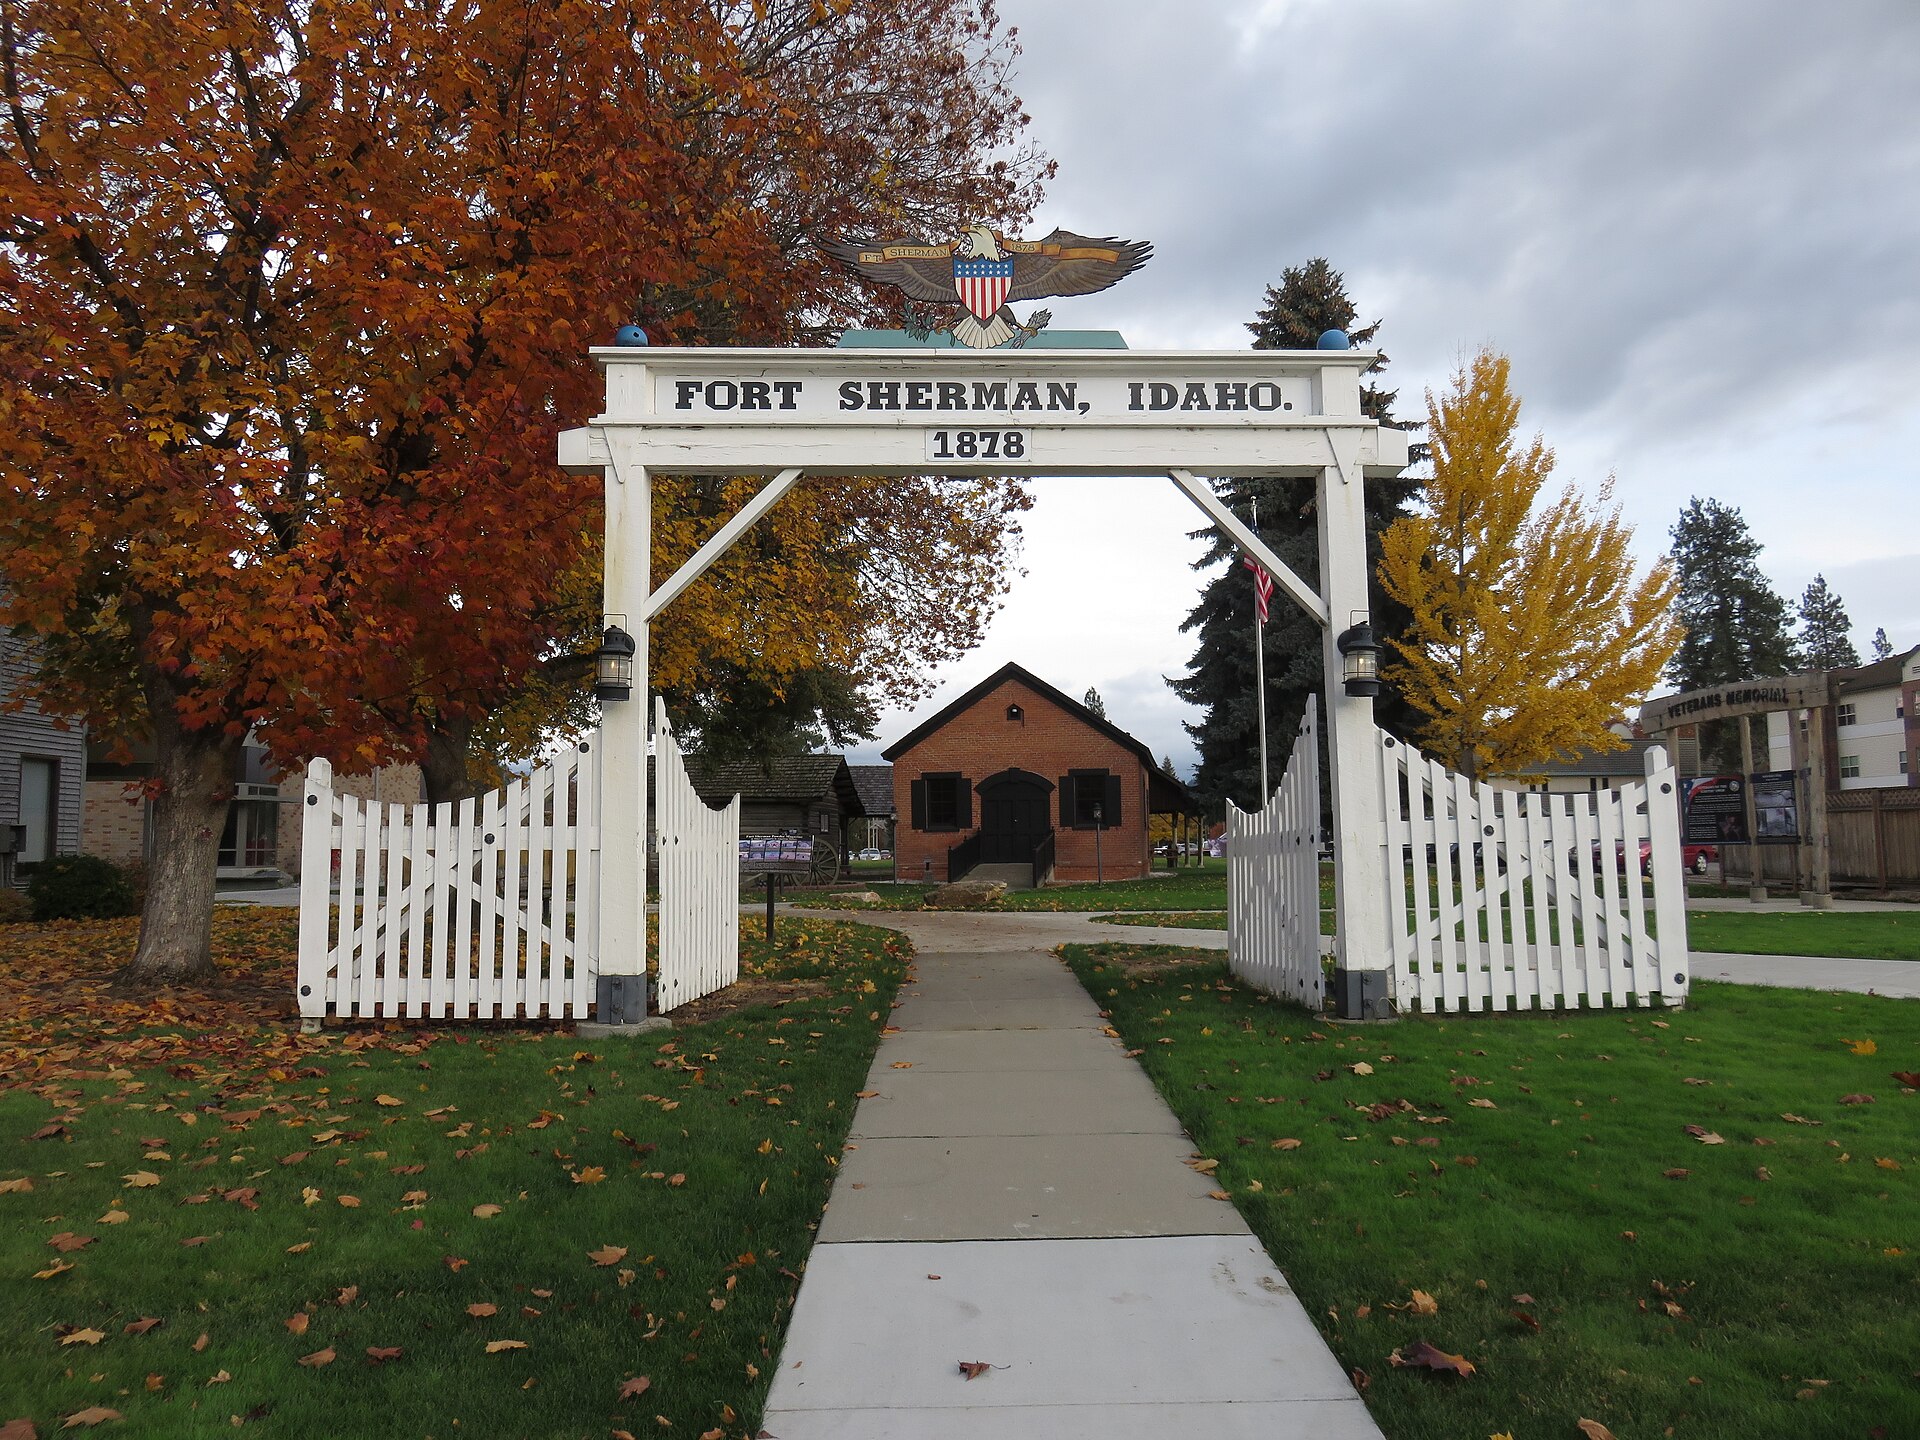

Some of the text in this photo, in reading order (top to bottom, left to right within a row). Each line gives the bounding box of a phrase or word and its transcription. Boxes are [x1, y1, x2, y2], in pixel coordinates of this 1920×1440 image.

[890, 248, 947, 257] SHERMAN
[1011, 243, 1036, 252] 1878
[675, 380, 1293, 415] FORT SHERMAN, IDAHO.
[933, 431, 1025, 459] 1878
[1667, 688, 1789, 718] VETERANS MEMORIAL
